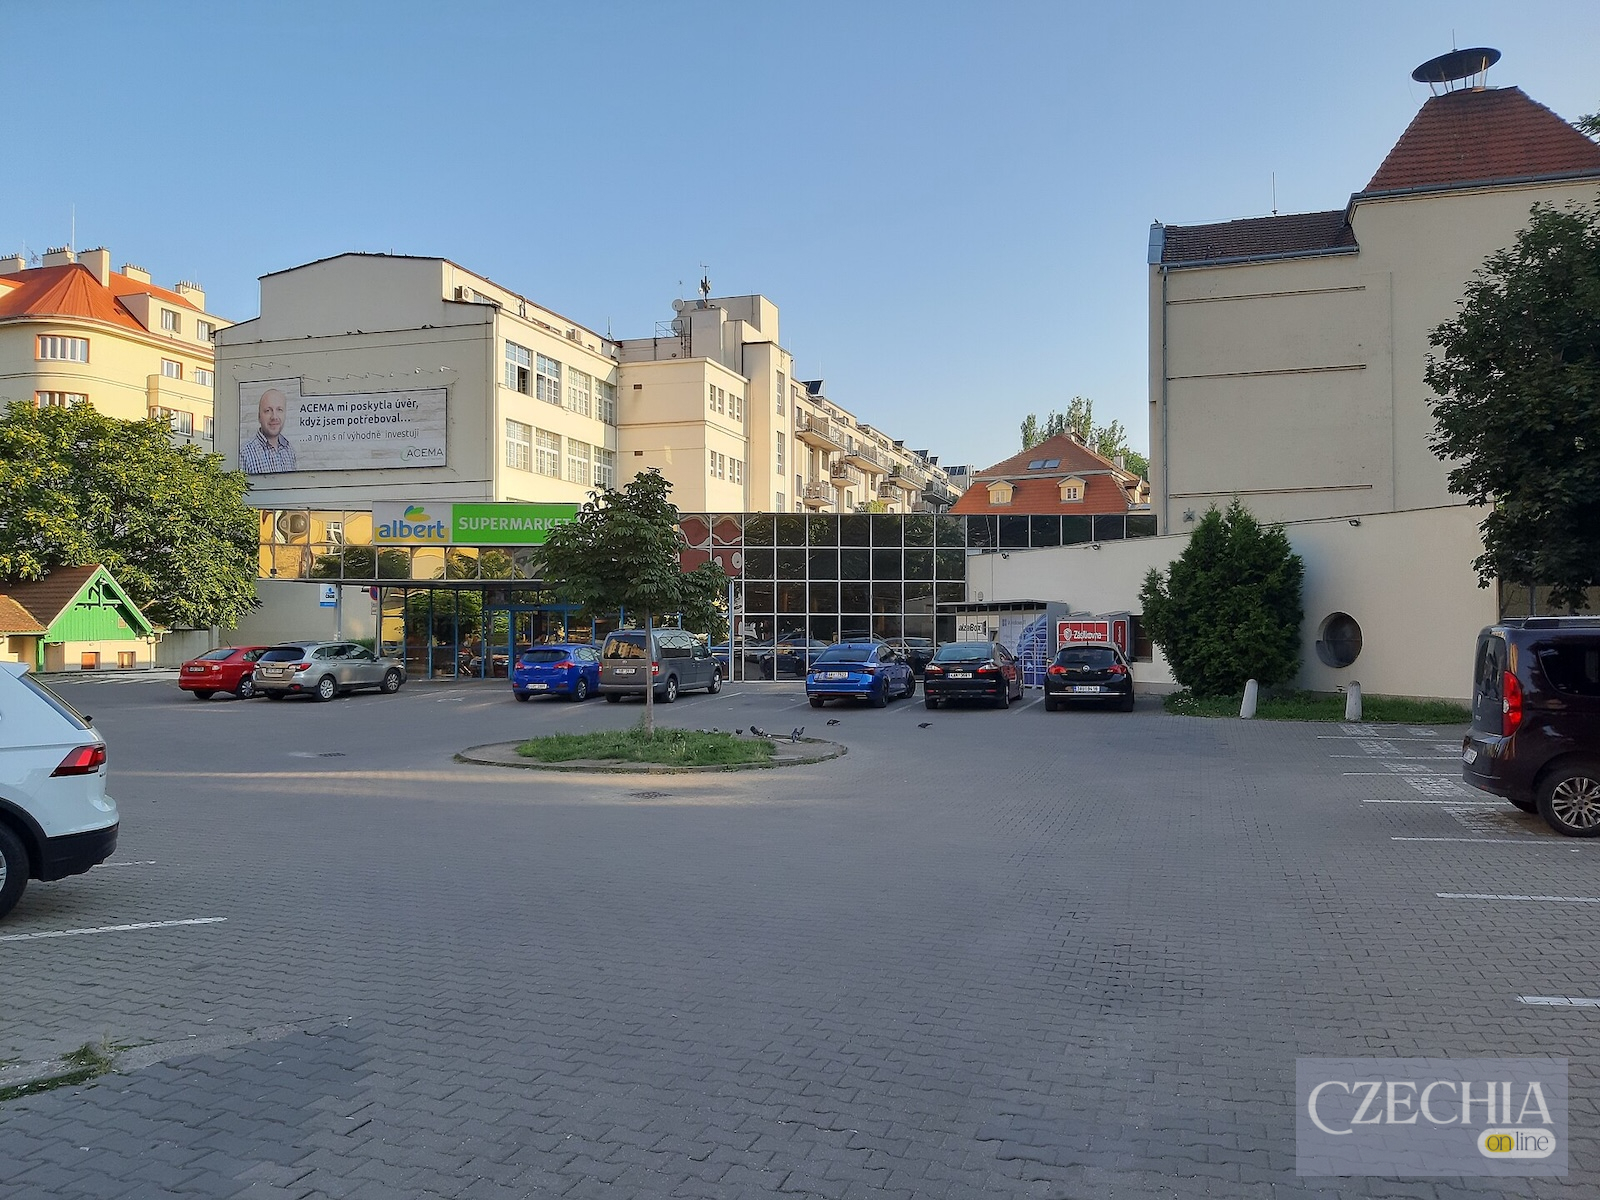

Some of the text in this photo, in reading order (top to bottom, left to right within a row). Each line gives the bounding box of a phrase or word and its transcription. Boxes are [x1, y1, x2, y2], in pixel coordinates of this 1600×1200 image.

[299, 398, 419, 413] ACEMA mi poskytla úvěr,
[299, 416, 321, 428] když
[322, 416, 345, 428] jsem
[346, 430, 382, 442] výhodně
[406, 447, 444, 458] ACEMA
[378, 520, 445, 539] albert
[458, 516, 572, 531] SUPERMARKET
